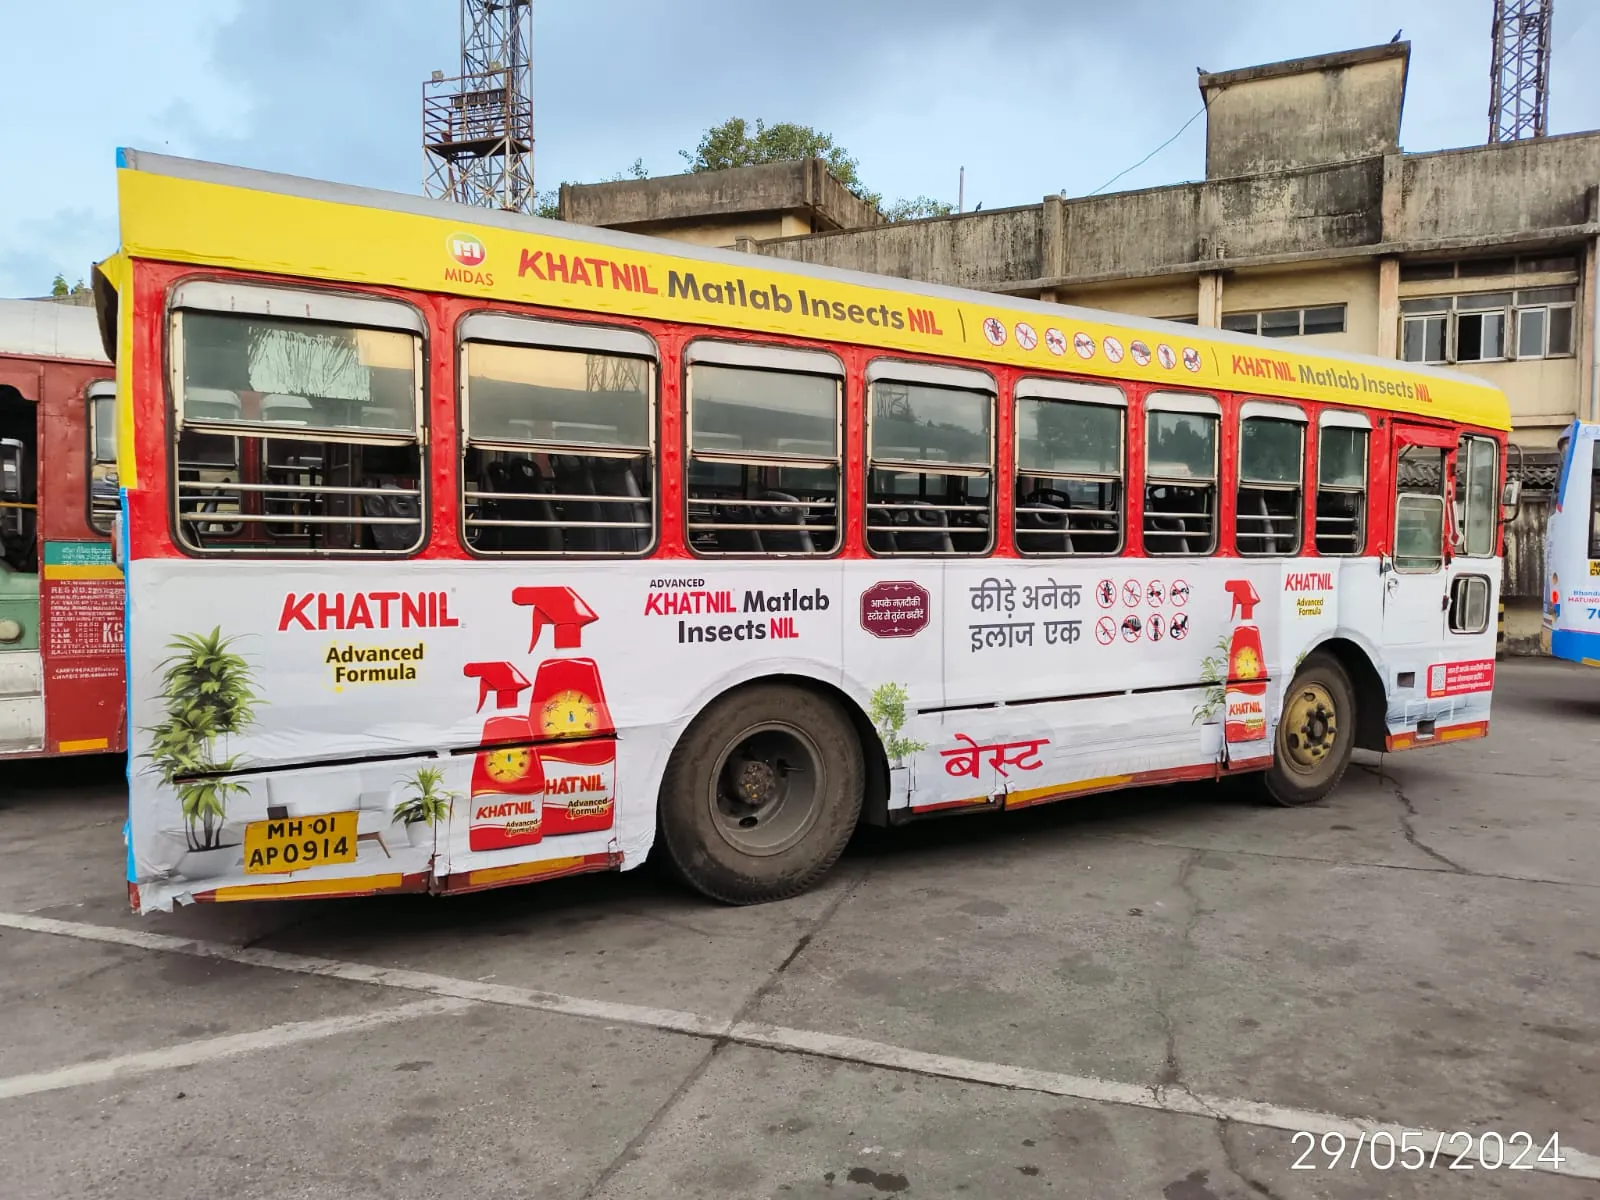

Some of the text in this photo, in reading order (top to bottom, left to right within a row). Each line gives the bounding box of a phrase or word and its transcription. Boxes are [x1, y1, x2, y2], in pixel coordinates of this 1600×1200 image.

[444, 268, 494, 286] MIDAS
[517, 248, 658, 295] KHATNIL
[668, 270, 792, 314] Matlab
[1232, 354, 1296, 382] KHATNIL
[1298, 364, 1359, 391] Matlab
[649, 578, 705, 588] ADVANCED
[1284, 573, 1334, 591] KHATNIL
[644, 588, 830, 616] KHATNIL Matlab
[870, 597, 892, 608] आपके
[969, 577, 1083, 619] कीड़े अनेक
[1296, 598, 1324, 607] Advanced
[278, 591, 459, 631] KHATNIL
[1298, 607, 1322, 616] Formula
[969, 619, 1083, 653] इलाज एक
[325, 643, 424, 664] Advanced
[335, 663, 417, 683] Formula
[1229, 700, 1263, 717] KHATNIL
[940, 733, 1051, 779] बेस्ट
[545, 773, 606, 796] HATNIL
[476, 801, 535, 820] KHATNIL
[568, 797, 608, 808] Advanced
[571, 806, 604, 815] Formula
[267, 821, 303, 840] MH
[506, 818, 539, 828] Advanced
[248, 836, 349, 868] AP0914
